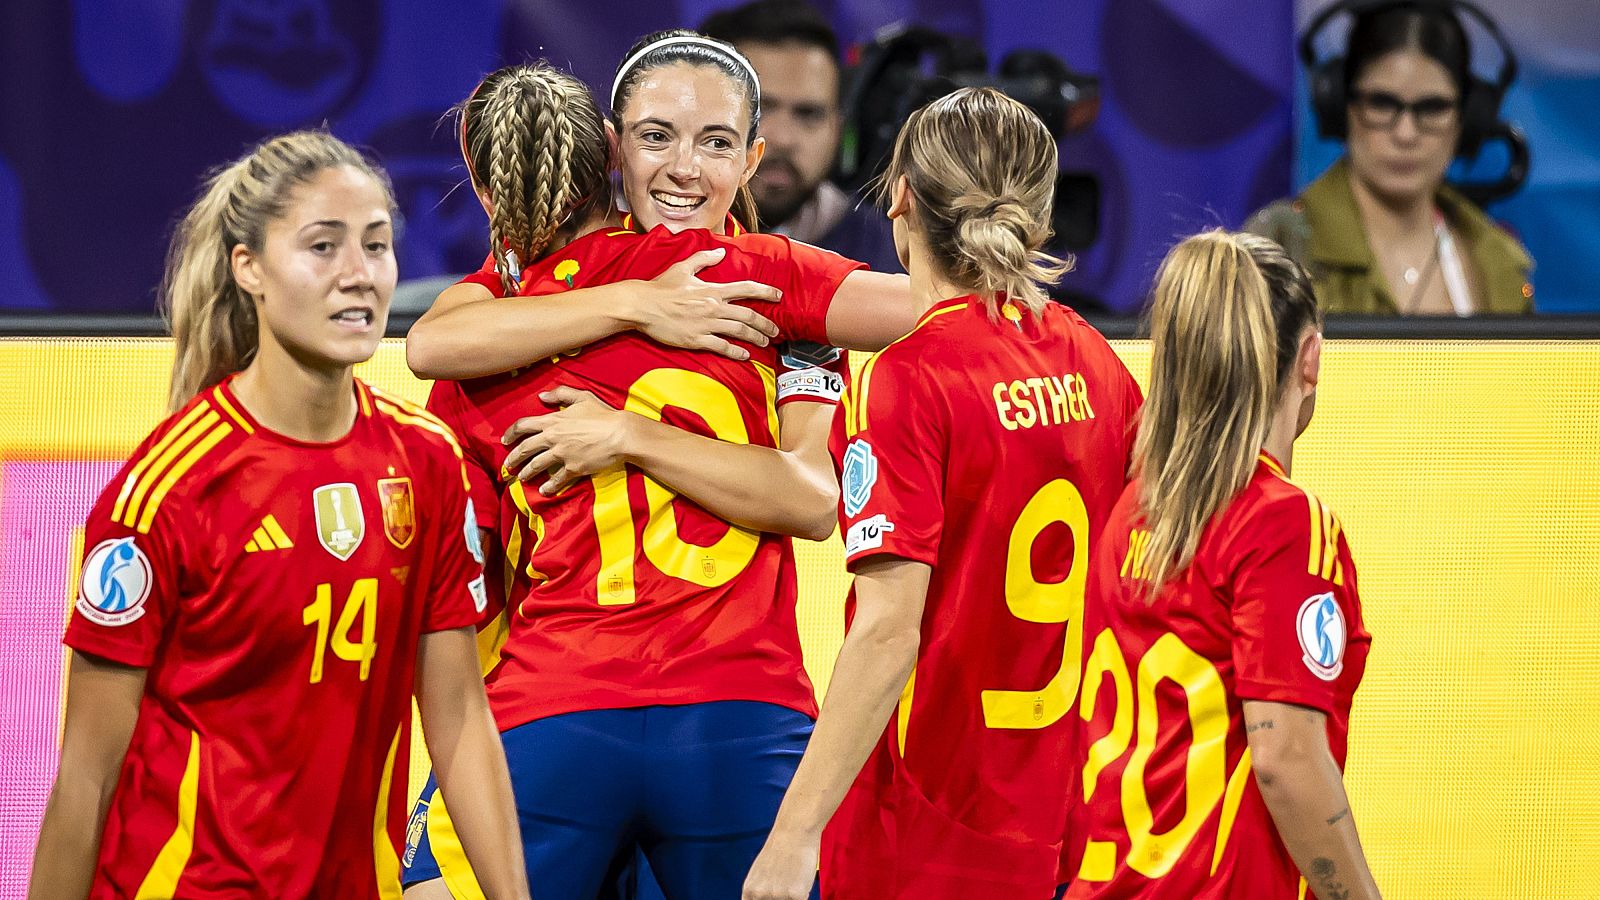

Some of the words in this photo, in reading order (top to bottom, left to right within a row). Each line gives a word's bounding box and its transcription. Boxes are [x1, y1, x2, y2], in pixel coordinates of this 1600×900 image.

[556, 367, 760, 606] 10
[992, 372, 1095, 431] ESTHER
[302, 577, 379, 684] 14
[981, 478, 1090, 729] 9
[1078, 626, 1230, 880] 20
